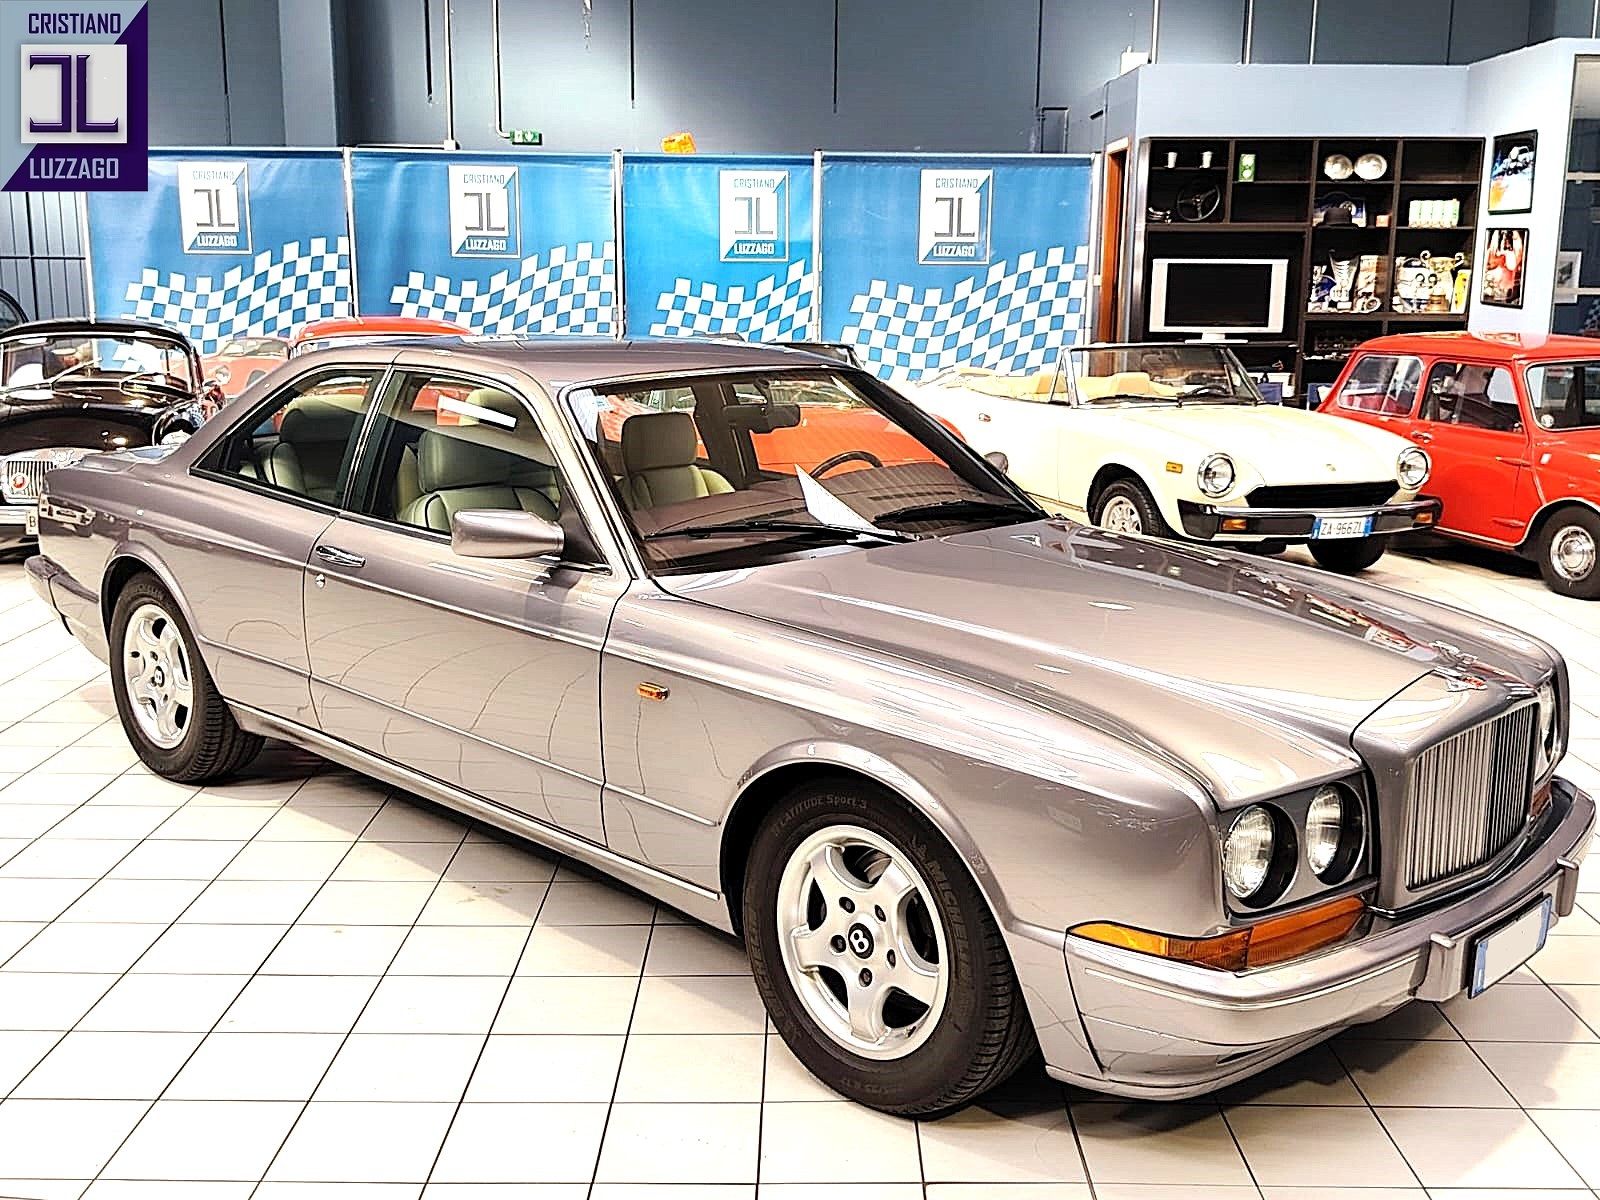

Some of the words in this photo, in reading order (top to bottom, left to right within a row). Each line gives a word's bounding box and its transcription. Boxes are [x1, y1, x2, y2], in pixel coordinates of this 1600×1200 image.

[192, 170, 235, 181] CRISTIANO
[463, 173, 505, 185] CRISTIANO
[733, 178, 775, 189] CRISTIANO
[935, 177, 979, 189] CRISTIANO
[197, 235, 238, 247] LUZZAGO
[465, 239, 507, 251] LUZZAGO
[733, 243, 775, 255] LUZZAGO
[933, 245, 976, 257] LUZZAGO
[825, 794, 859, 807] Sport
[850, 929, 870, 953] B
